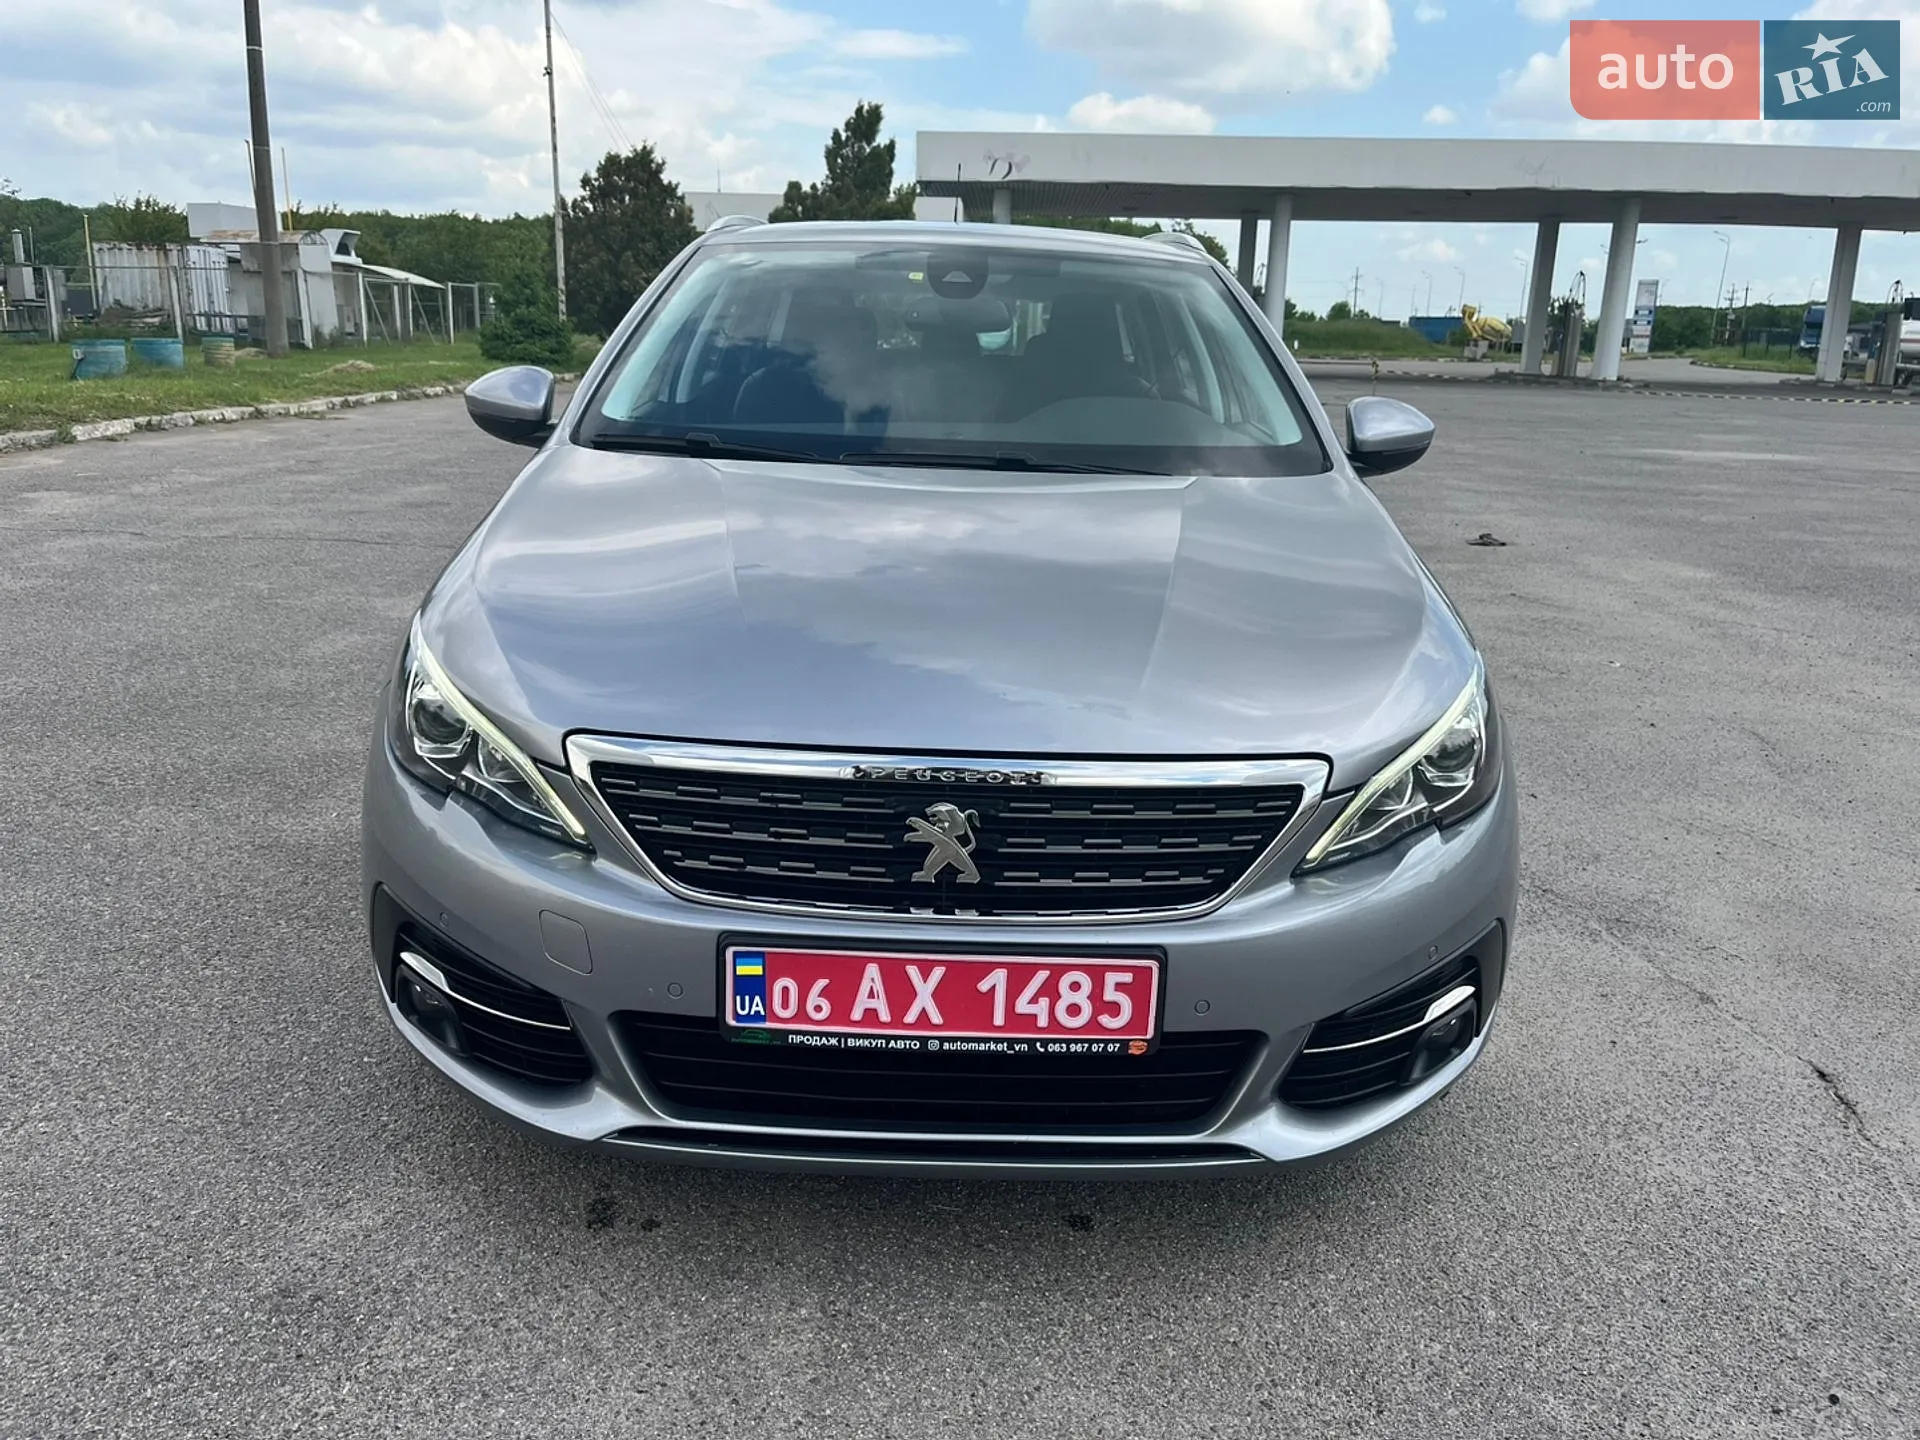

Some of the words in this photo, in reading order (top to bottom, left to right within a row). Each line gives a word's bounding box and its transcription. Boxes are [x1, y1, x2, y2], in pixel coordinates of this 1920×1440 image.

[736, 995, 765, 1015] UA
[771, 976, 833, 1021] 06
[850, 963, 946, 1025] AX
[976, 967, 1134, 1030] 1485
[788, 1034, 839, 1047] ПРОДАЖ
[847, 1037, 887, 1049] ВИКУП
[888, 1039, 921, 1050] АВТО
[942, 1040, 1029, 1054] automarket_vn
[1047, 1042, 1067, 1053] 063
[1069, 1042, 1089, 1053] 967
[1091, 1042, 1106, 1053] 07
[1107, 1042, 1121, 1053] 07
